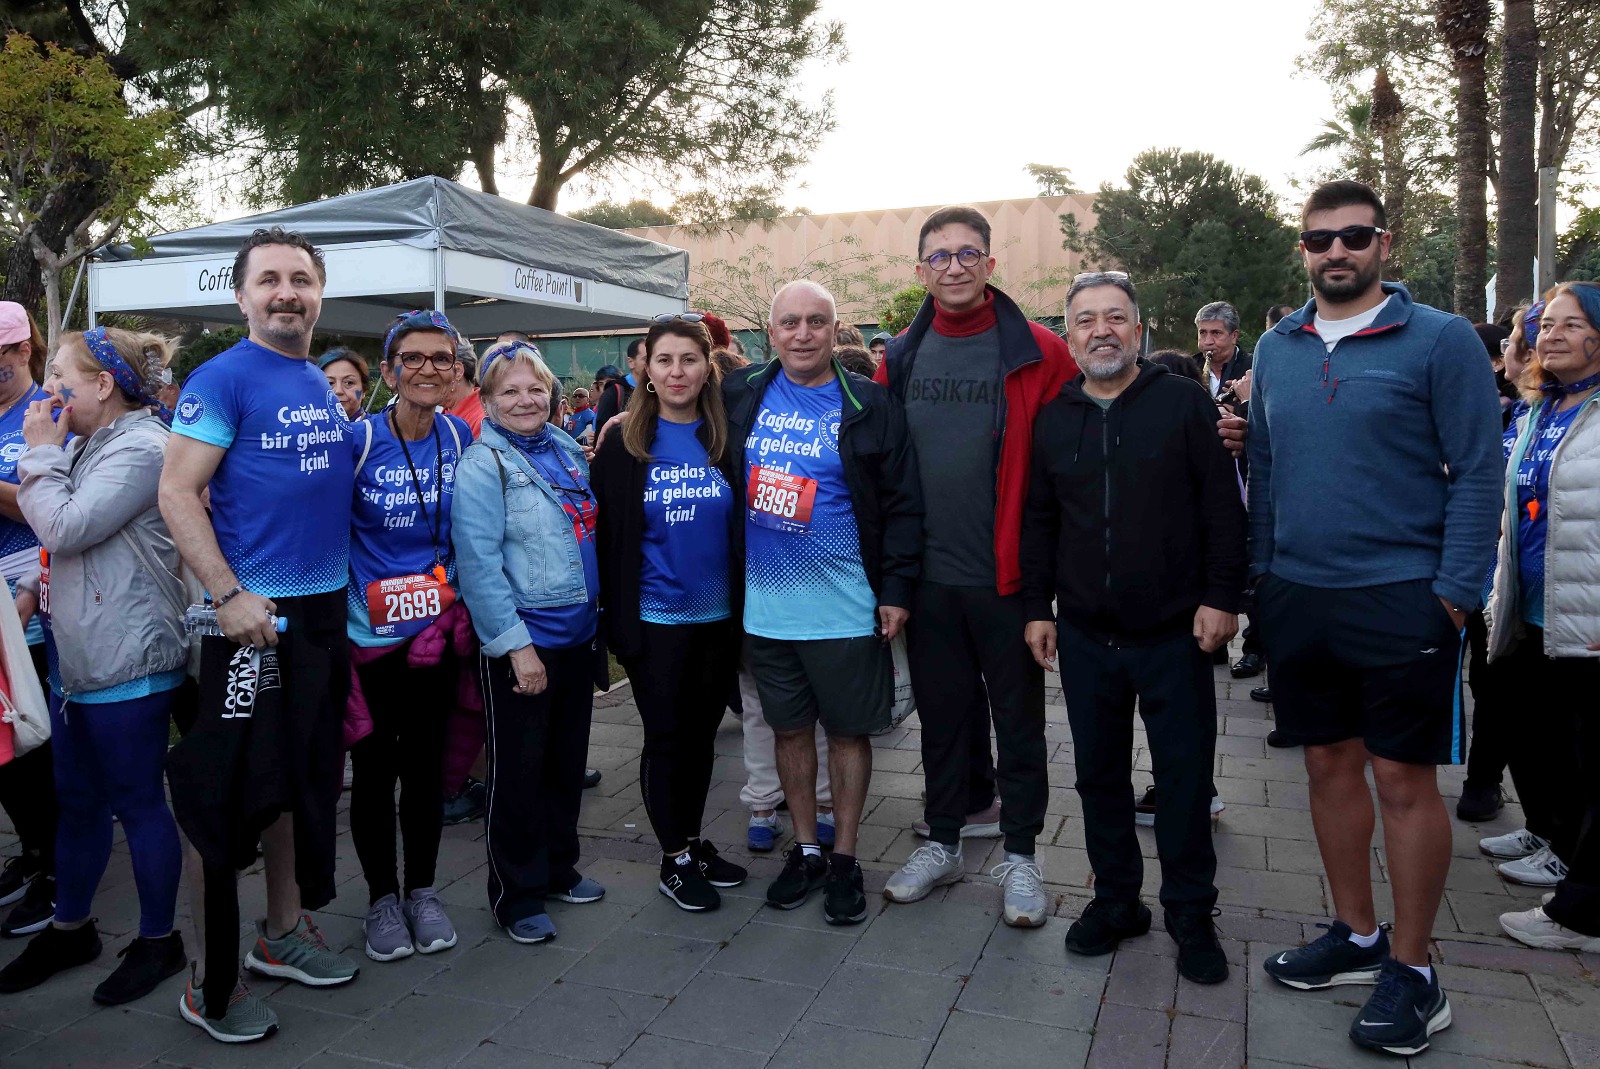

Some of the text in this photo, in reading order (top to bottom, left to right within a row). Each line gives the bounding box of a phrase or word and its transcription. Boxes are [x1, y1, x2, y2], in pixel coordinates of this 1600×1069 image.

[198, 266, 235, 291] Coffe
[515, 267, 544, 293] Coffee
[277, 403, 330, 429] Çağdaş
[757, 408, 816, 436] Çağdaş
[261, 424, 344, 452] bir gelecek
[758, 433, 824, 459] gelecek
[300, 449, 330, 475] için!
[374, 463, 430, 487] Çağdaş
[650, 462, 706, 485] Çağdaş
[662, 480, 722, 505] gelecek
[753, 483, 799, 518] 3393
[383, 510, 417, 531] için!
[665, 504, 697, 527] için!
[385, 588, 441, 623] 2693
[221, 668, 240, 719] LOOK
[236, 664, 257, 707] CAN
